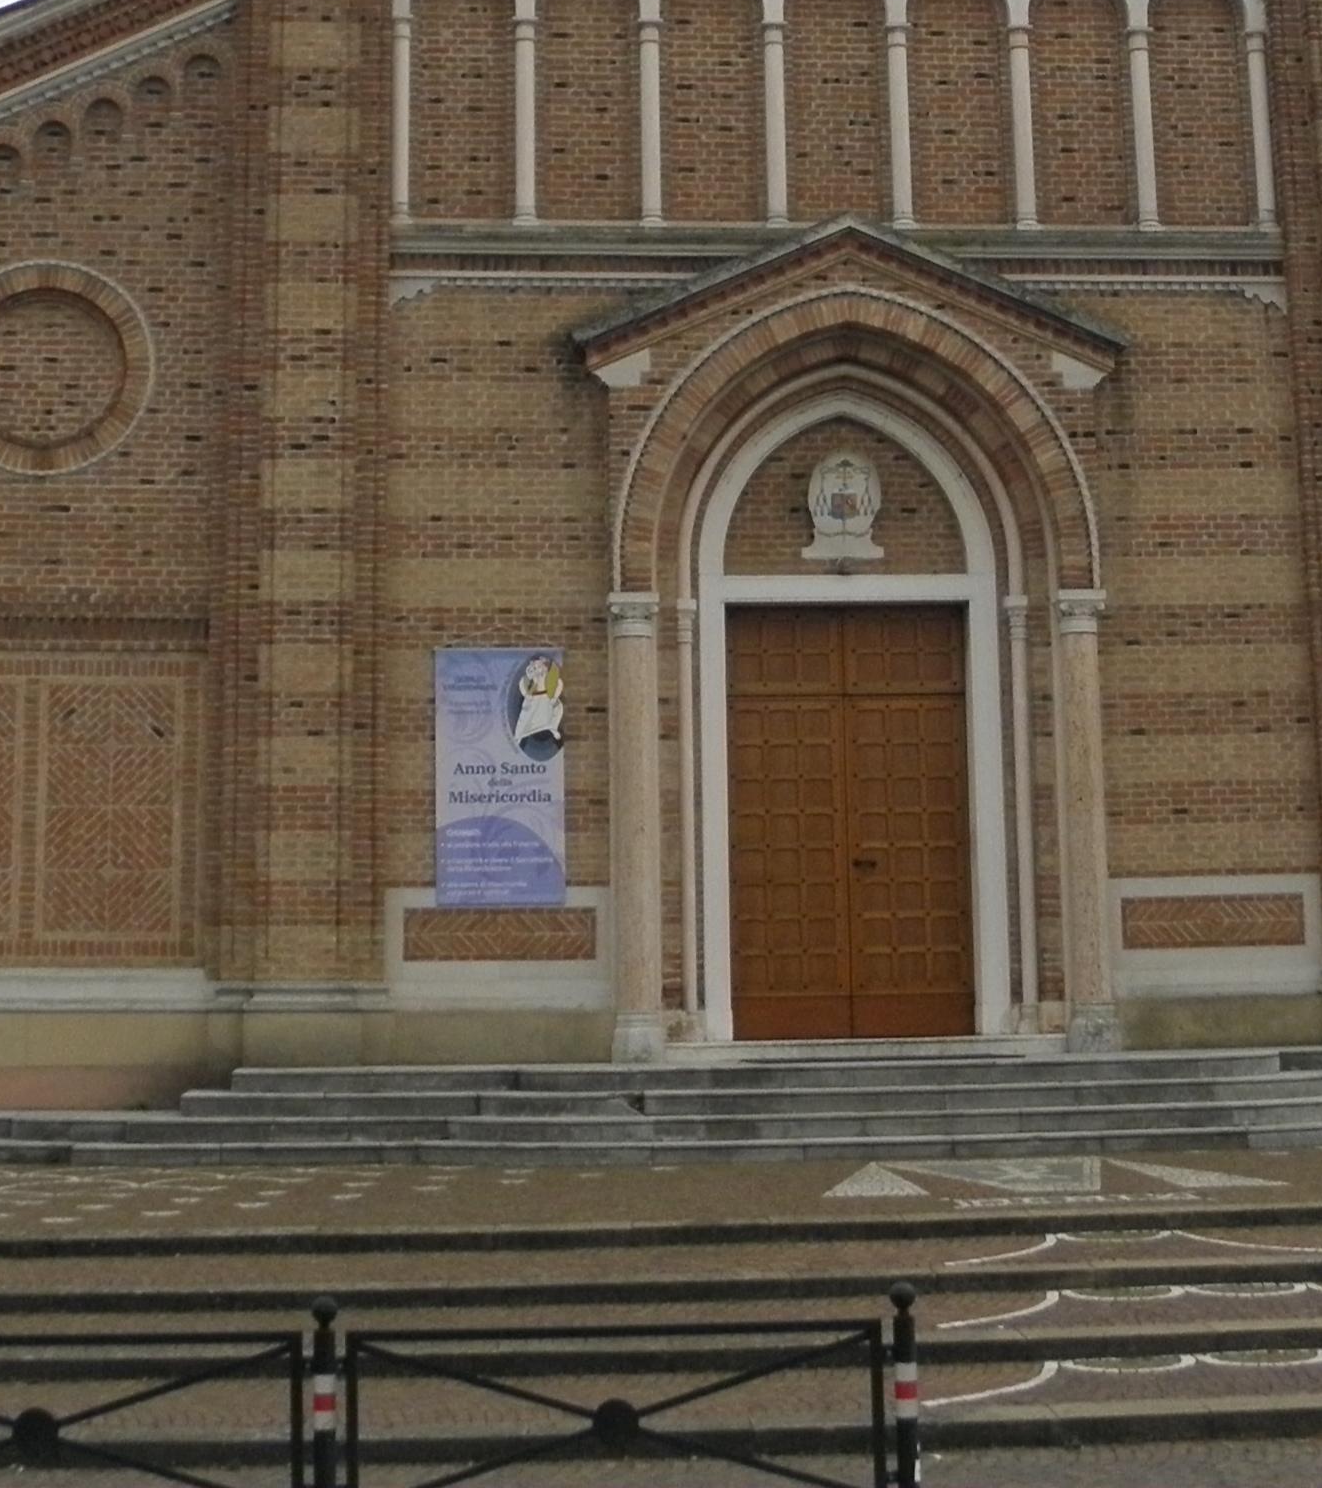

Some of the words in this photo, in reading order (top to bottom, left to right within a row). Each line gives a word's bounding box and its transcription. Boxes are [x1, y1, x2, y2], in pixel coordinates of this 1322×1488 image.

[453, 761, 497, 775] Anno
[500, 761, 547, 775] Santo
[448, 789, 552, 804] Misericordia
